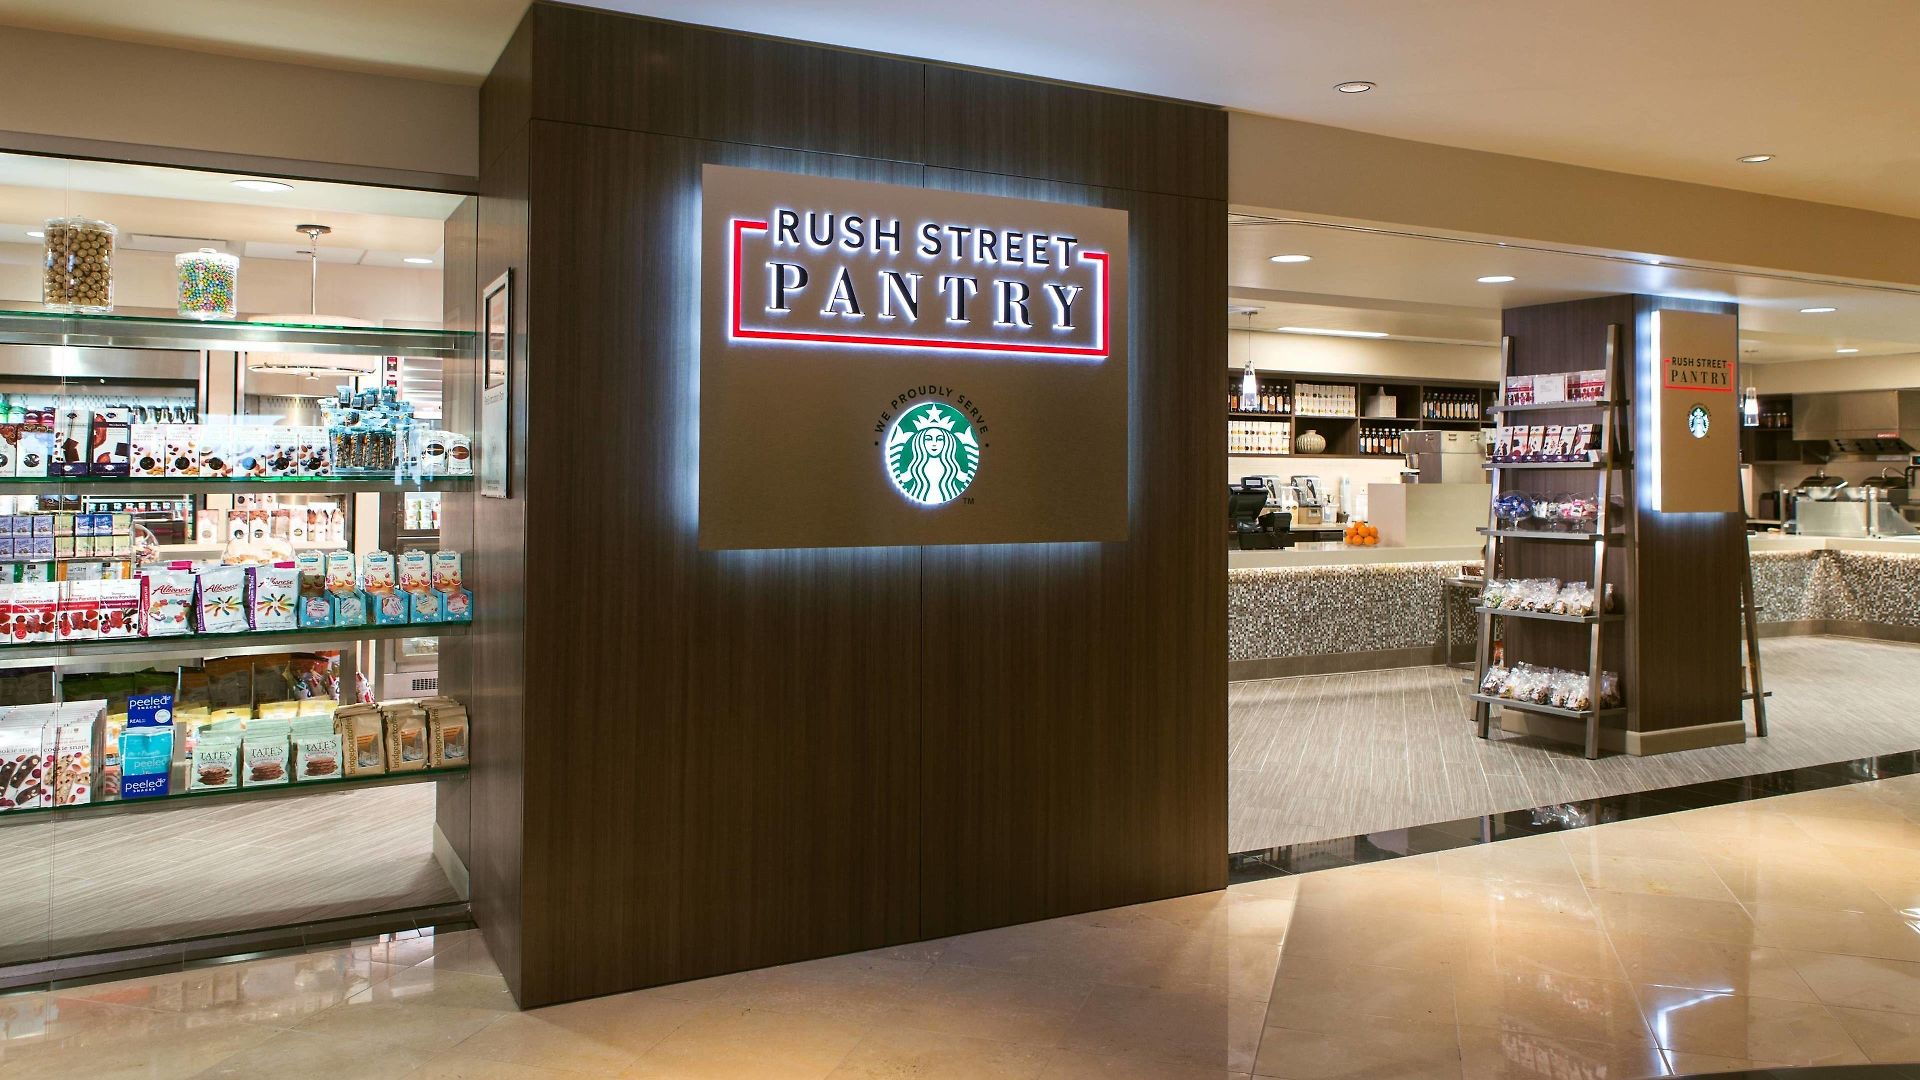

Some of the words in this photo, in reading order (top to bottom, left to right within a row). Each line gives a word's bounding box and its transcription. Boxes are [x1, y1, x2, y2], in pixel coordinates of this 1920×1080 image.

[776, 208, 900, 252] RUSH
[920, 222, 1078, 268] STREET
[768, 261, 1083, 328] PANTRY
[1671, 356, 1695, 367] RUSH
[1696, 358, 1728, 369] STREET
[1670, 369, 1729, 385] PANTRY
[875, 411, 891, 434] WE
[890, 385, 953, 410] PROUDLY
[957, 394, 989, 434] SERVE
[129, 696, 168, 709] peeled
[69, 744, 90, 752] snaps
[251, 746, 284, 757] TATE'S
[304, 739, 338, 751] TATE'S
[200, 751, 232, 760] TATE'S
[125, 779, 163, 793] peeled
